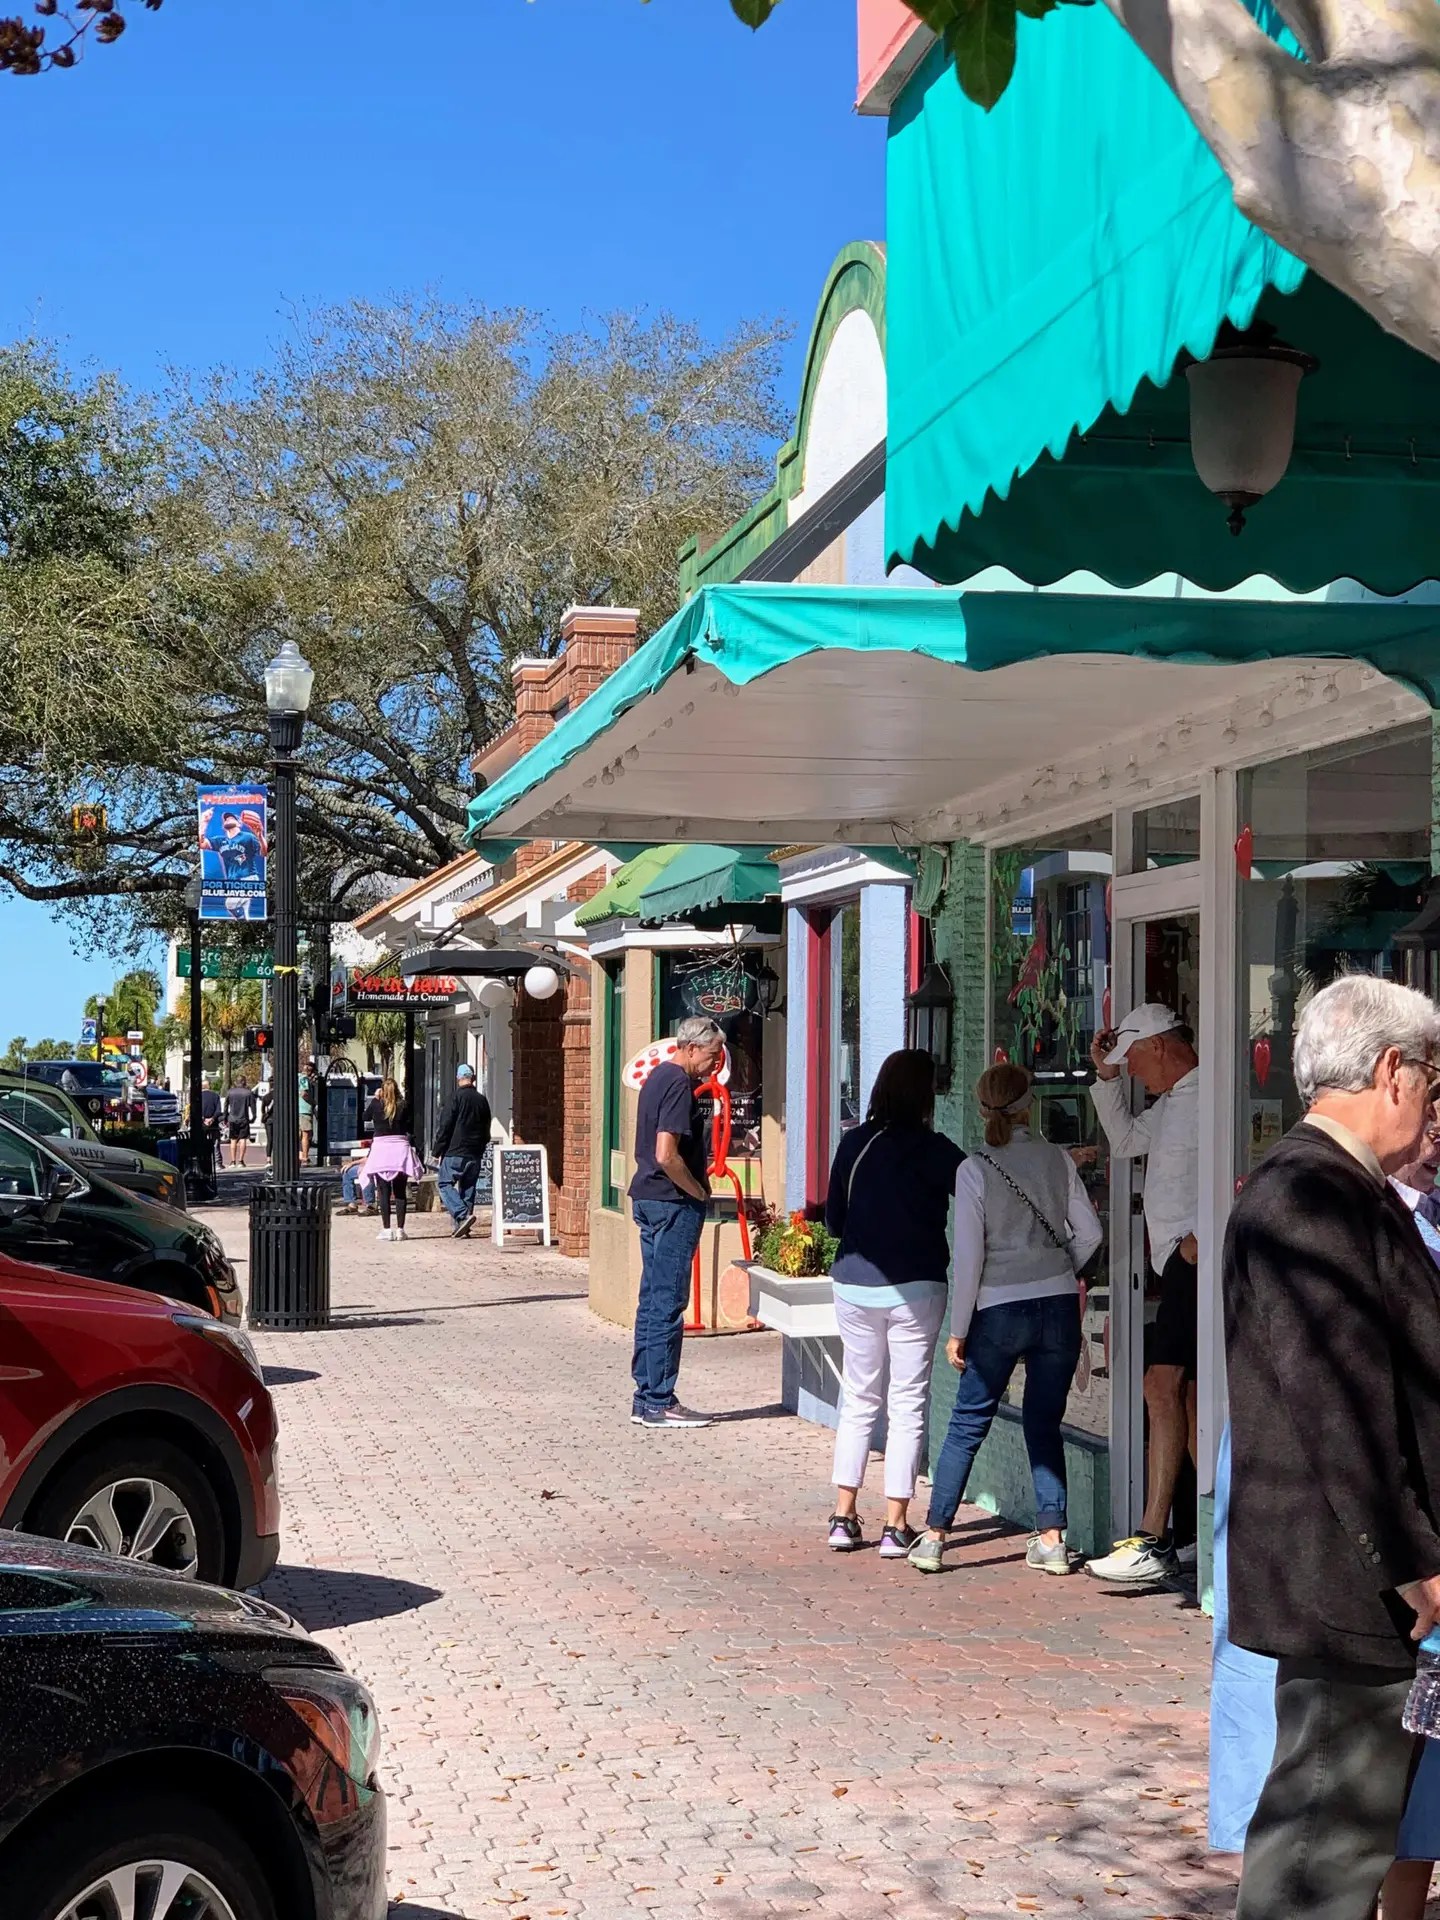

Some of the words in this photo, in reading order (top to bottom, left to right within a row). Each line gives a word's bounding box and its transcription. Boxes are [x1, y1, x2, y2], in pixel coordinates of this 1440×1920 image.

[202, 881, 223, 889] FOR
[224, 882, 266, 890] TICKETS
[201, 889, 266, 897] BLUEJAYS.COM
[199, 948, 269, 966] Broay
[184, 964, 209, 975] 70
[256, 965, 275, 976] 80
[351, 967, 458, 994] Stracan's
[357, 992, 404, 1001] Homemade
[405, 992, 419, 1002] Ice
[420, 993, 450, 1002] Cream
[69, 1146, 105, 1160] WILLYS
